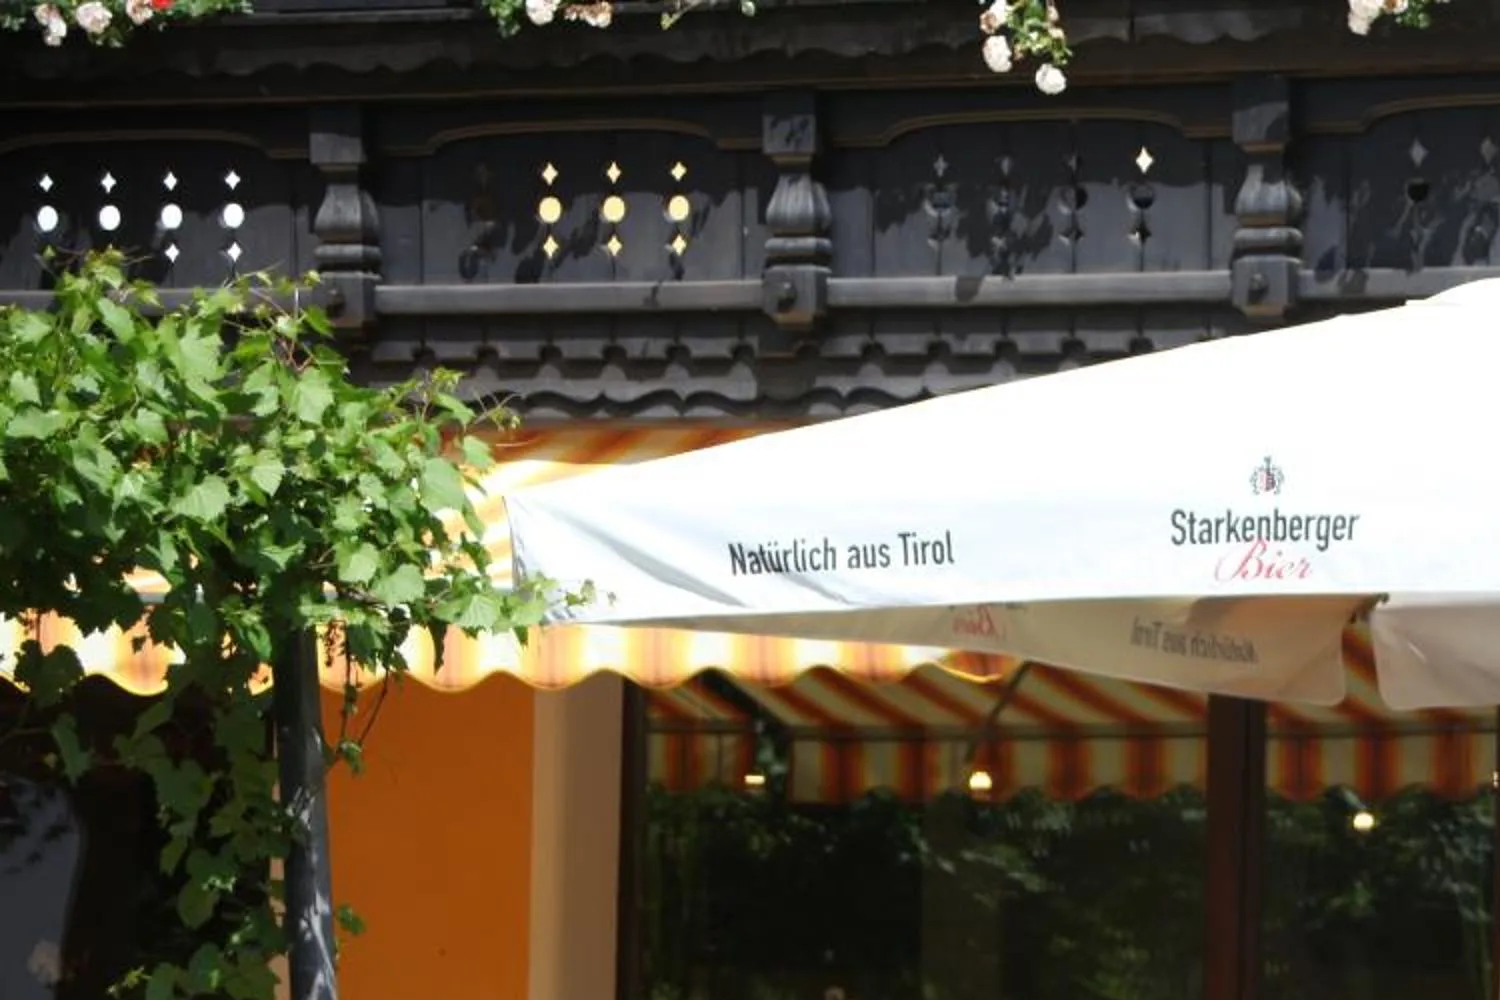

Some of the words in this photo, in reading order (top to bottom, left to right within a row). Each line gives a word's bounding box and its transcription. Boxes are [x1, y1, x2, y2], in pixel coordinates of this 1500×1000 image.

[728, 537, 837, 576] Natürlich
[847, 543, 891, 569] aus
[897, 529, 955, 566] Tirol
[1171, 508, 1360, 552] Starkenberger
[1214, 537, 1312, 583] Bier
